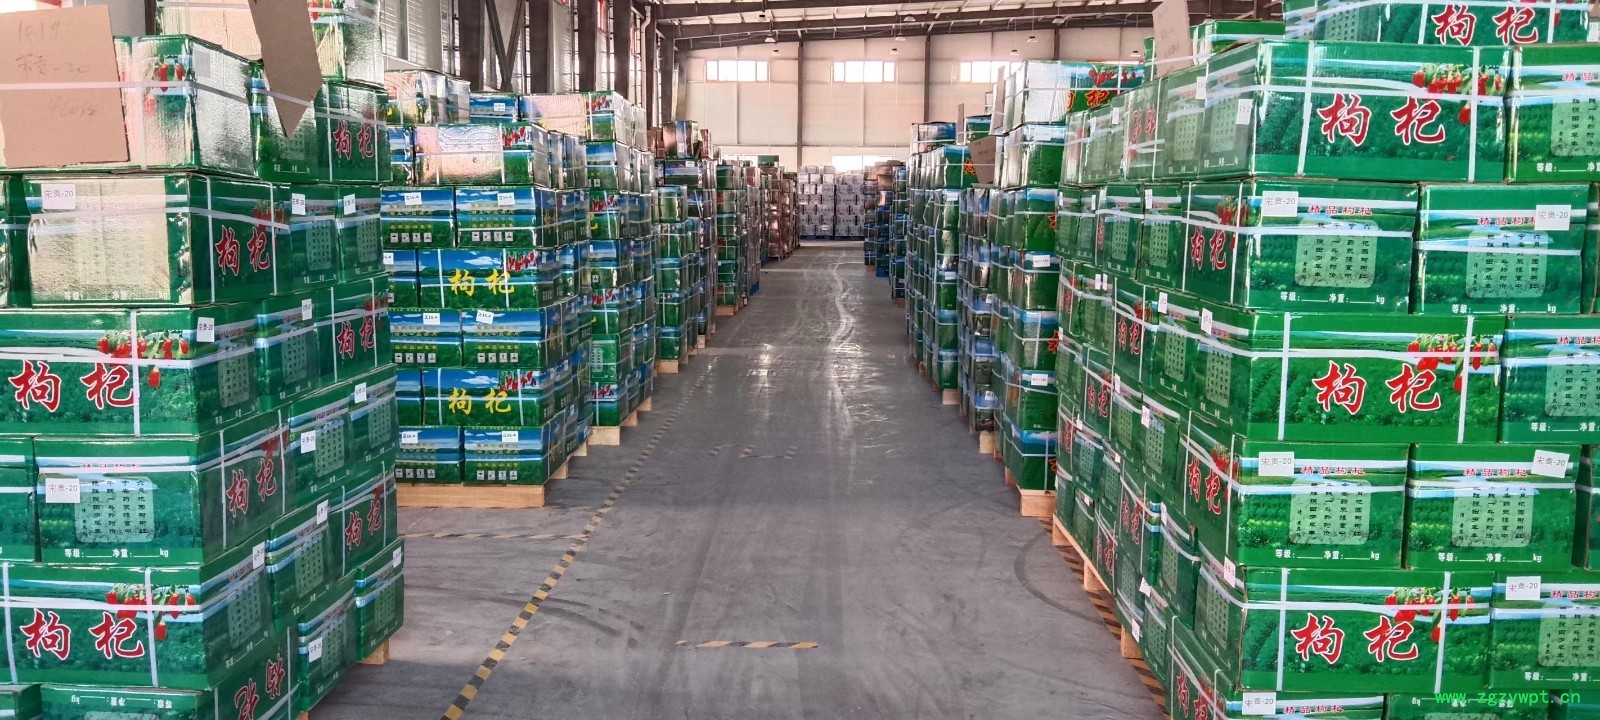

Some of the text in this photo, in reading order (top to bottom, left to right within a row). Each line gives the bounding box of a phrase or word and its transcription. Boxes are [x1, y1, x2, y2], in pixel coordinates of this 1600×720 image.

[1432, 4, 1538, 46] 枸杞
[1317, 92, 1446, 146] 枸杞
[333, 120, 375, 160] 枸杞
[1308, 205, 1372, 216] 精品枸杞
[215, 225, 271, 276] 枸杞
[1191, 226, 1227, 270] 枸杞
[449, 268, 515, 297] 枸杞
[1376, 295, 1385, 304] kg
[1547, 305, 1556, 313] kg
[337, 315, 375, 359] 枸杞
[8, 360, 134, 412] 枸杞
[448, 387, 511, 415] 枸杞
[1312, 360, 1441, 414] 枸杞
[226, 458, 277, 518] 枸杞
[1301, 466, 1365, 475] 精品枸杞
[1464, 469, 1527, 477] 精品枸杞
[345, 500, 382, 550] 枸杞
[160, 549, 168, 558] kg
[1371, 551, 1380, 560] kg
[1533, 554, 1542, 562] kg
[20, 608, 144, 660] 枸杞
[1291, 613, 1418, 664] 枸杞
[71, 695, 80, 704] kg
